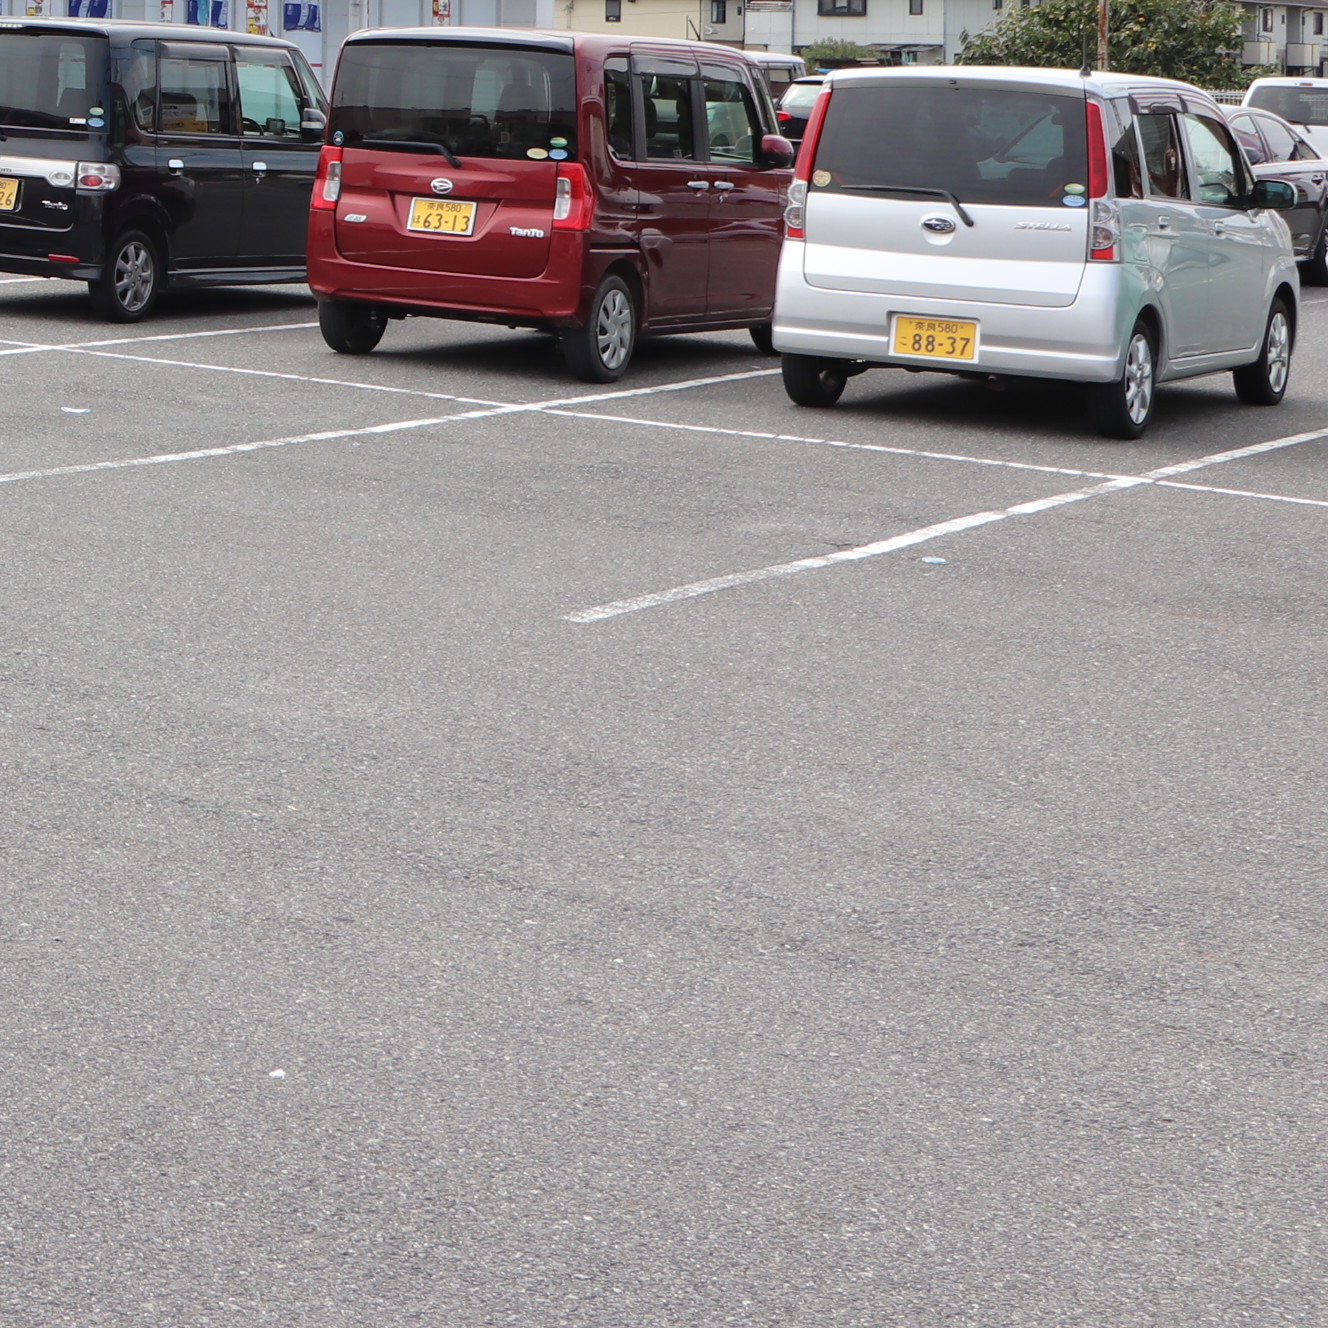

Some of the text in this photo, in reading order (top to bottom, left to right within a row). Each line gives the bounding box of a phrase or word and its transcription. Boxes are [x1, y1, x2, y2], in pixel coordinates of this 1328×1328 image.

[422, 212, 470, 232] 63-13
[1015, 221, 1072, 232] STELLA
[914, 322, 958, 334] 奈良580
[911, 333, 971, 356] 88-37
